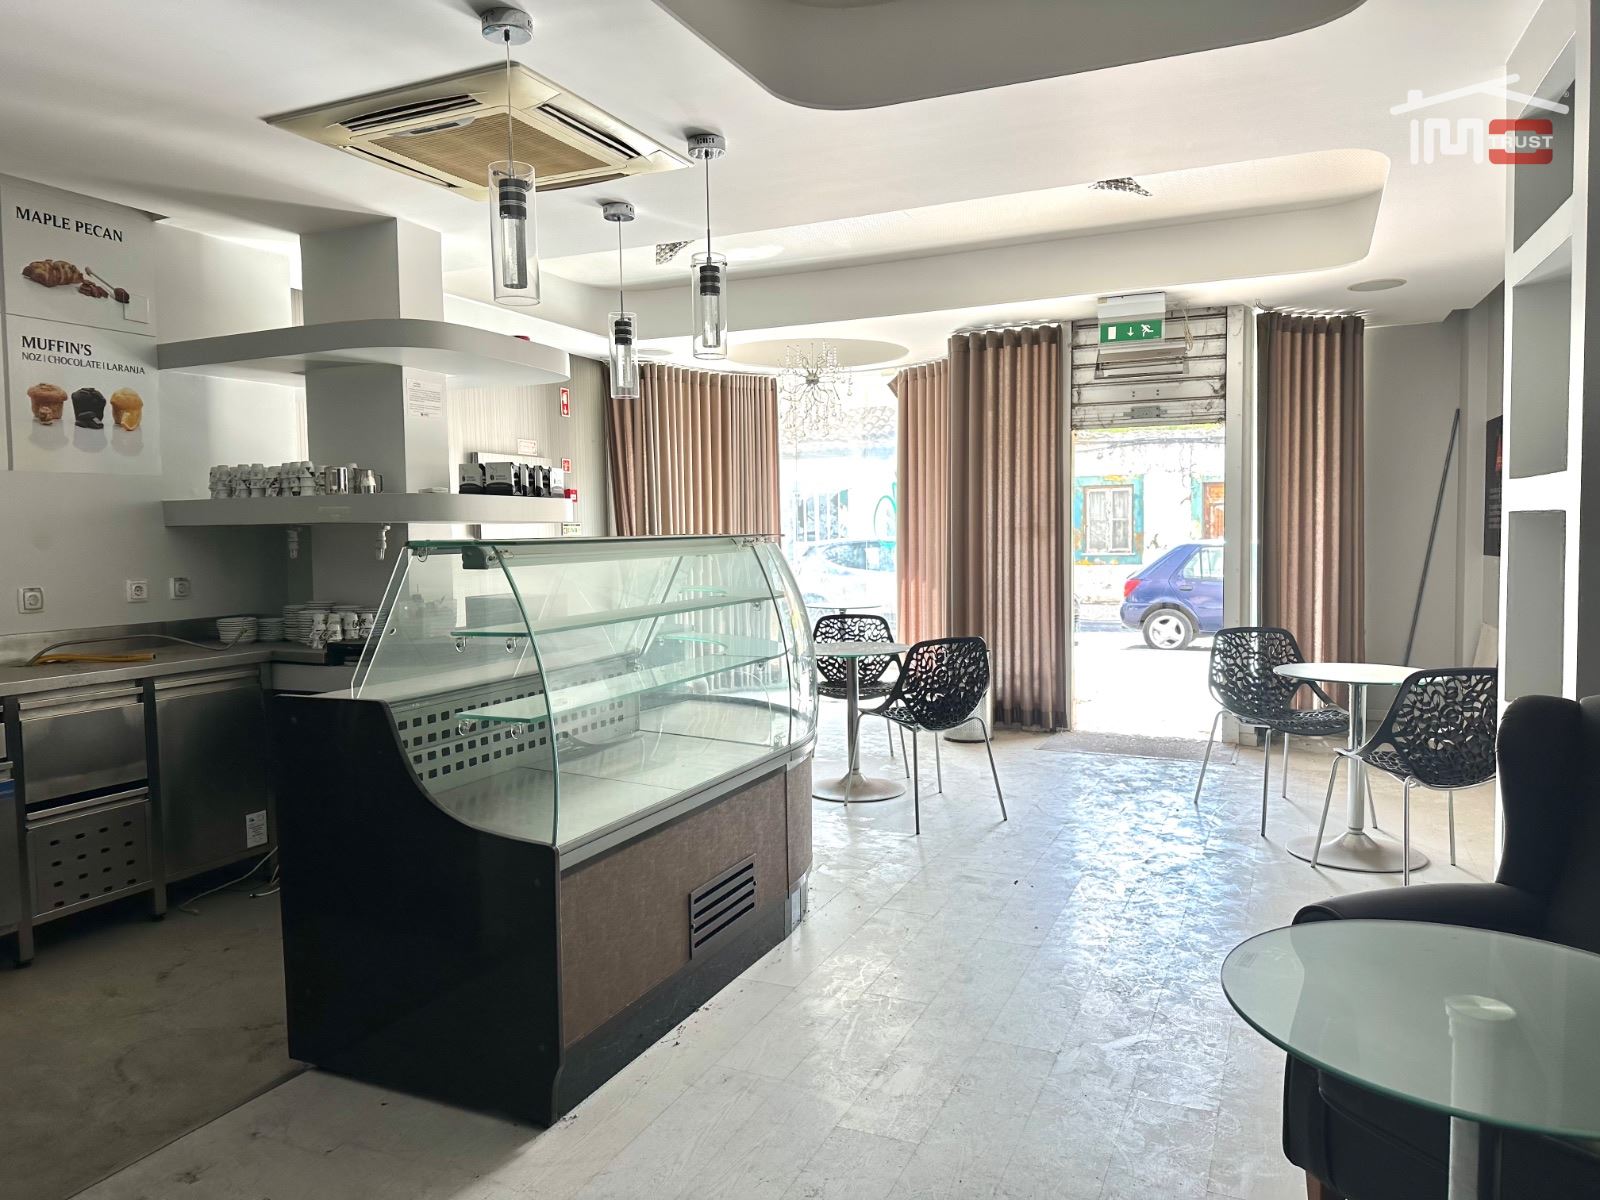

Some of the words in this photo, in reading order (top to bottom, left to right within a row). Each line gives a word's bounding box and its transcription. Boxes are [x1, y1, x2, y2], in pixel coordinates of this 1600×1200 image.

[16, 206, 71, 230] MAPLE
[75, 221, 123, 242] PECAN
[22, 336, 92, 356] MUFFIN'S
[22, 352, 42, 361] NOZ
[47, 355, 102, 370] CHOCOLATE
[106, 362, 146, 375] LARANJA
